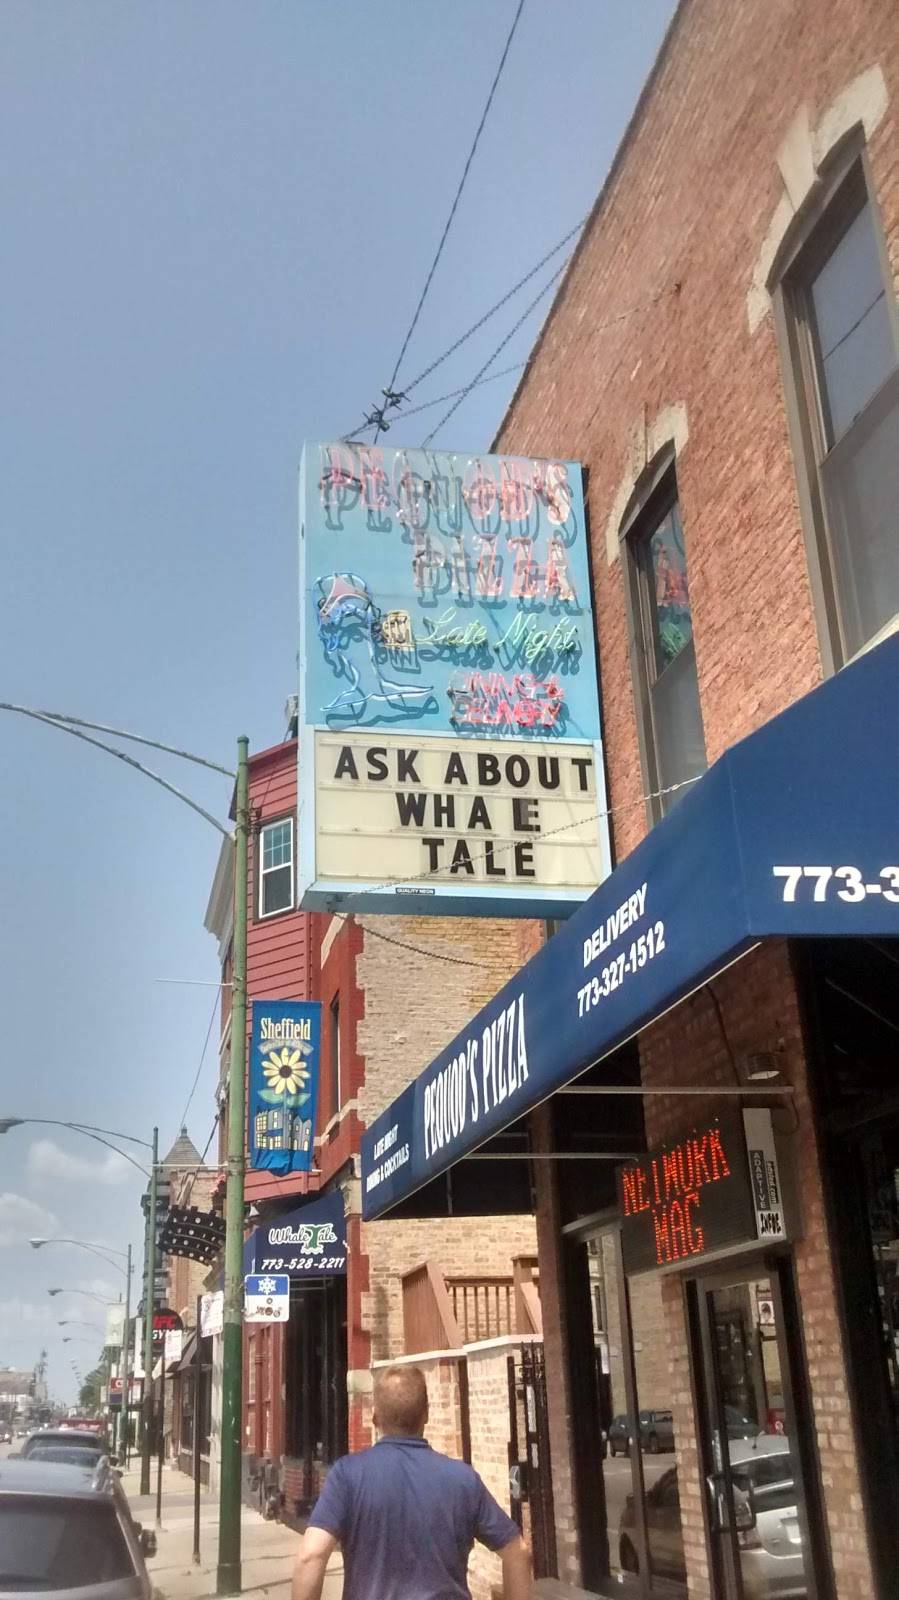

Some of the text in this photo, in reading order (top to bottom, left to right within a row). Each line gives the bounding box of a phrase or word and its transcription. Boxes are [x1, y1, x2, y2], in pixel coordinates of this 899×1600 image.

[416, 607, 578, 663] Late Night
[334, 746, 592, 791] ASK ABOUT
[422, 838, 535, 876] TALE
[584, 882, 647, 968] DELIVERY
[577, 921, 665, 1017] 773-327-1512
[260, 1017, 311, 1040] Sheffield
[424, 993, 529, 1160] PEQUOD'S PIZZA
[753, 1152, 767, 1209] ADAPTIVE
[269, 1226, 313, 1245] Whale
[261, 1257, 345, 1270] 773-528-2211
